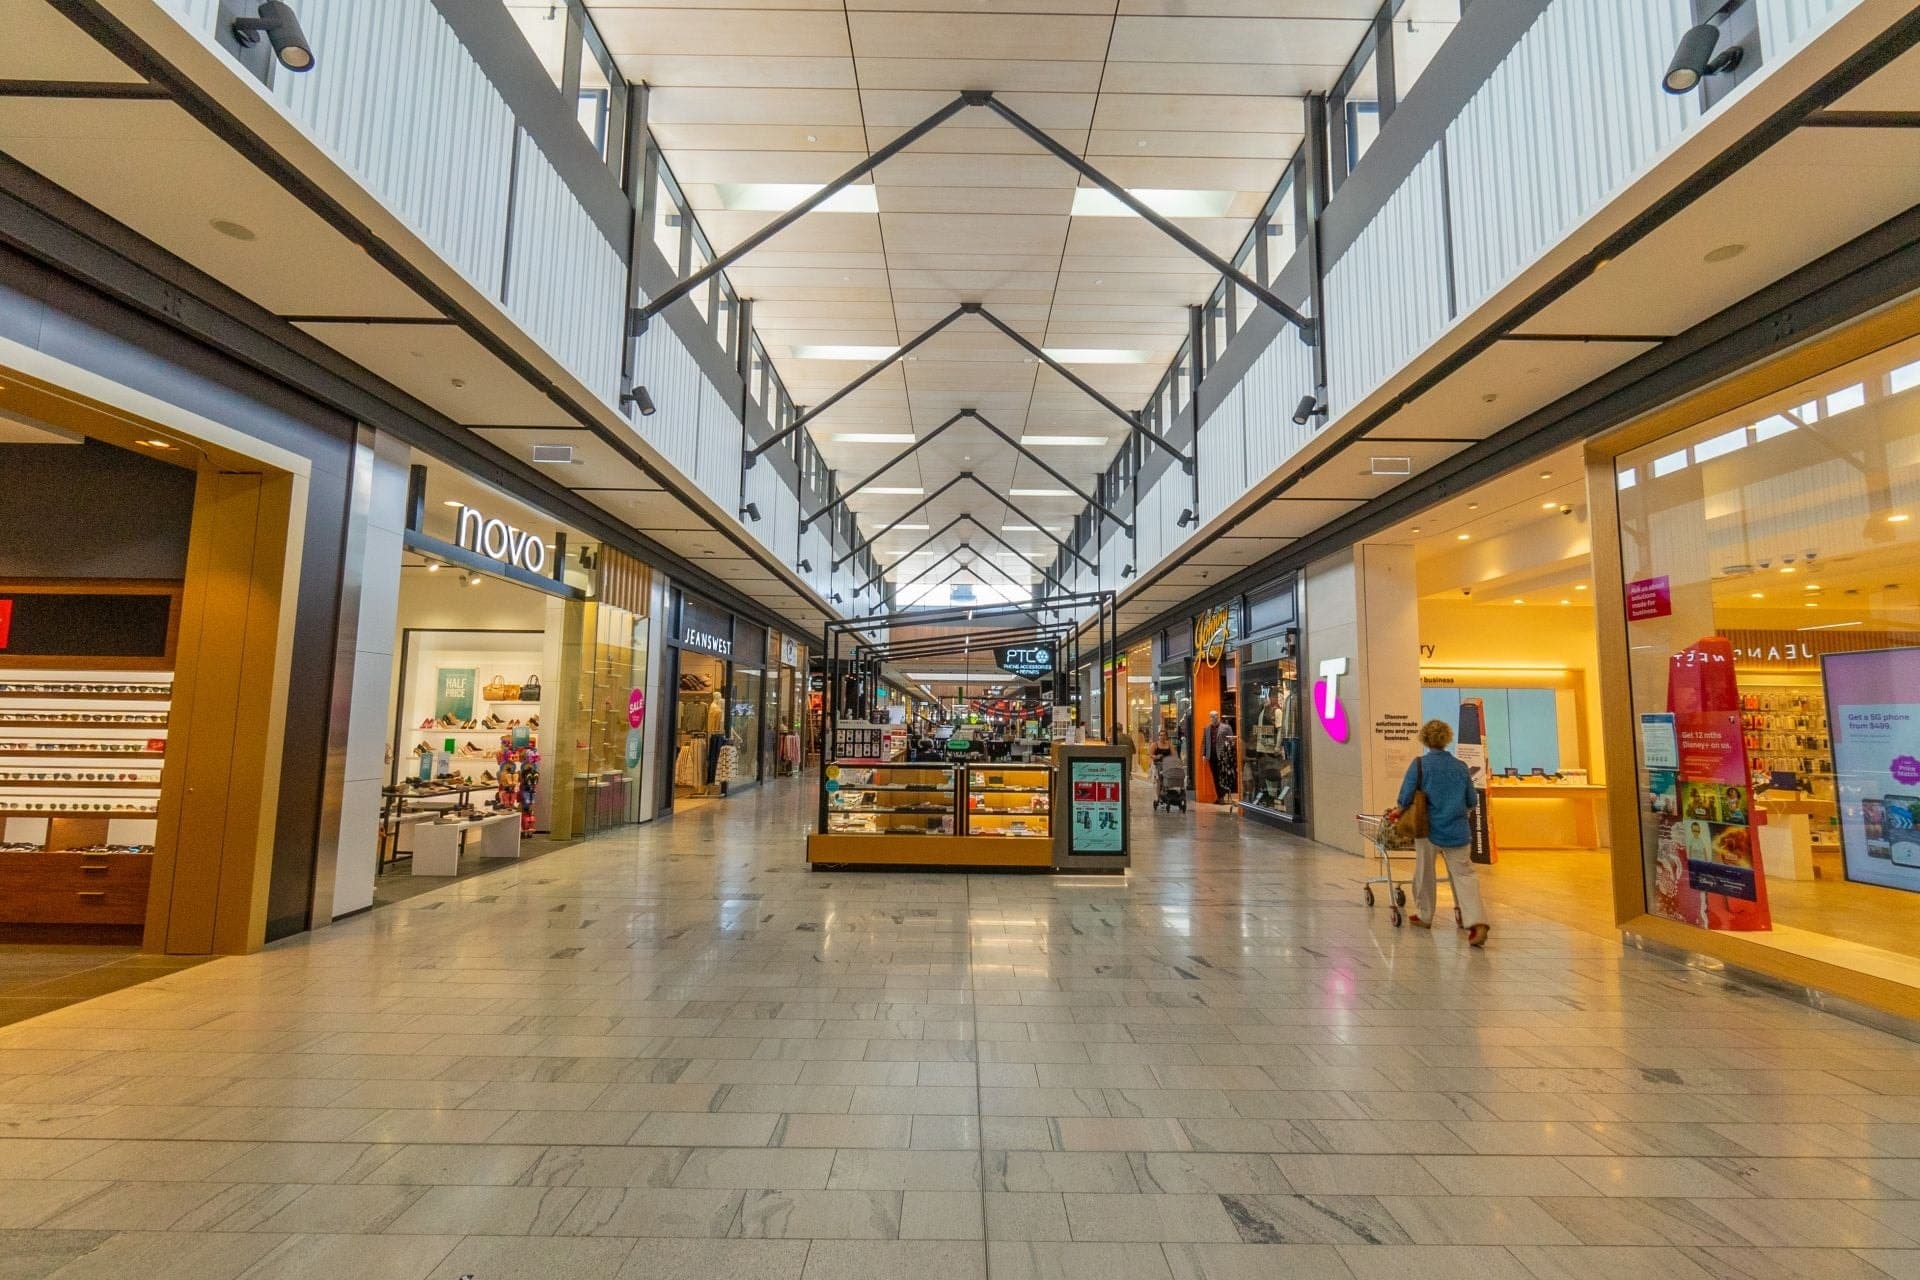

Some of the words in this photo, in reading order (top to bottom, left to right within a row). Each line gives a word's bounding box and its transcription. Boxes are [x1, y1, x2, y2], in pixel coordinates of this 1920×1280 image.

[459, 505, 544, 573] novo
[684, 627, 732, 655] JEANSWEST
[446, 678, 467, 689] HALF
[1319, 656, 1347, 719] T
[445, 688, 466, 698] PRICE
[1883, 712, 1909, 722] phone
[1681, 731, 1694, 739] Get
[1695, 731, 1704, 739] 12
[1704, 731, 1722, 739] mths
